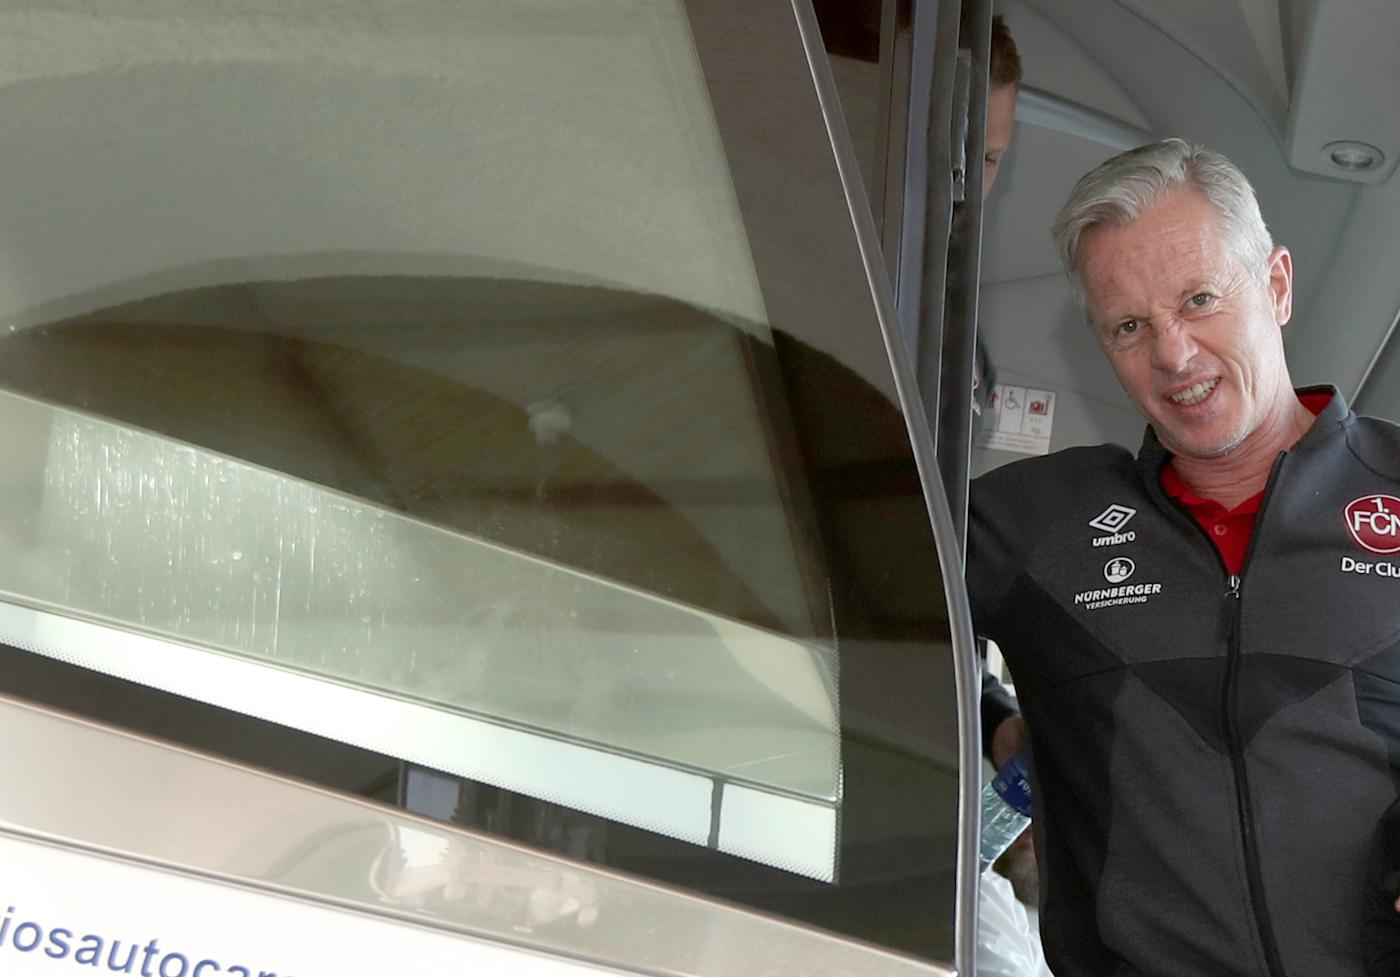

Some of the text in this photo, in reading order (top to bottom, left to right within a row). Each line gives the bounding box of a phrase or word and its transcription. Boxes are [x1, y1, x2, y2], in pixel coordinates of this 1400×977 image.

[1092, 531, 1136, 547] umbro
[1341, 557, 1373, 574] Der
[1085, 596, 1148, 610] VERSICHERUNG
